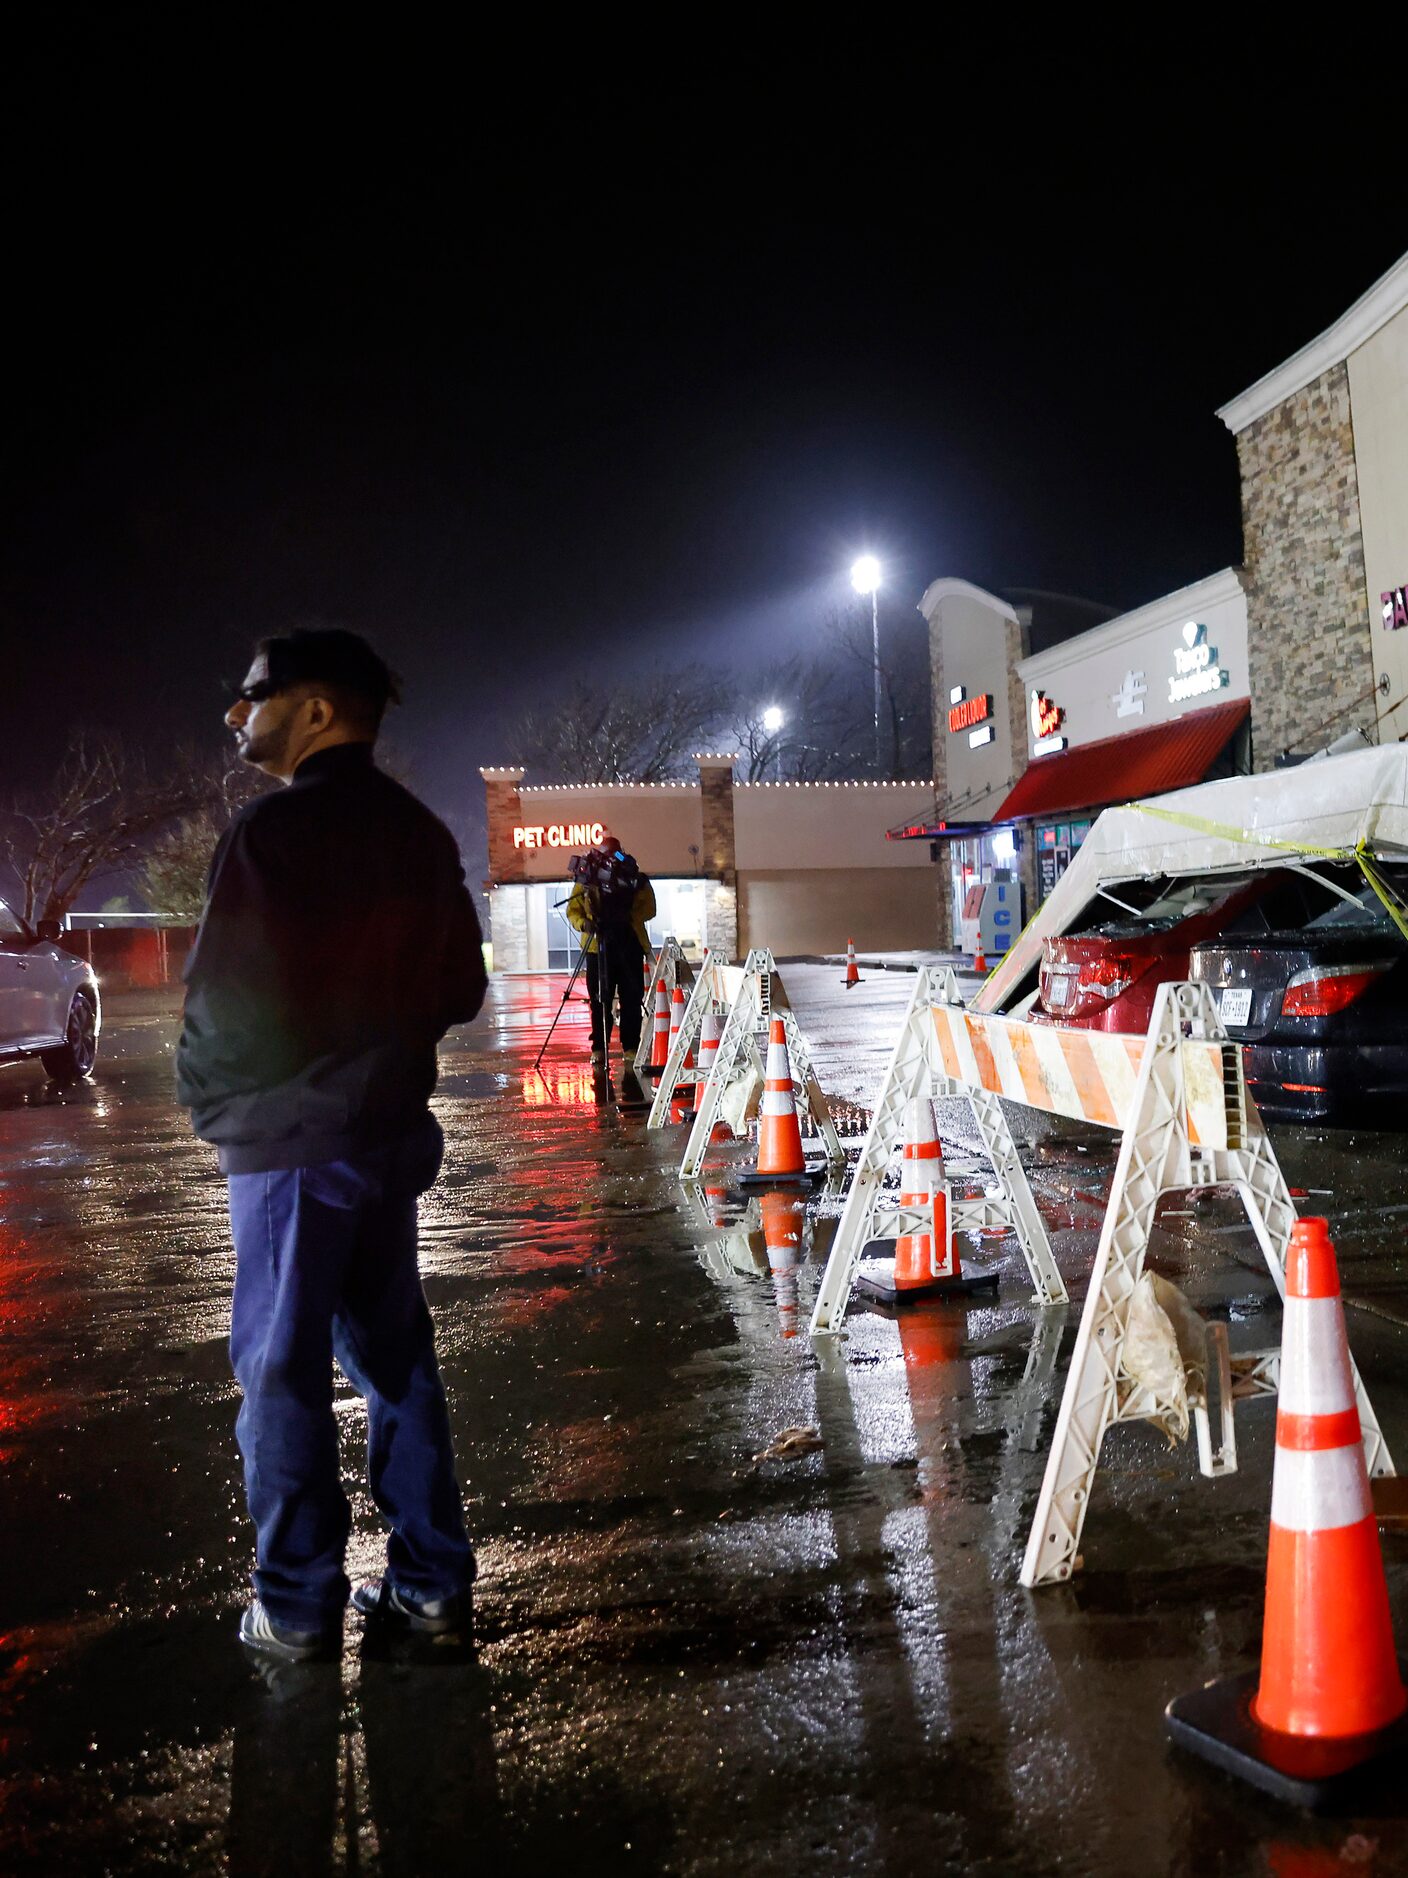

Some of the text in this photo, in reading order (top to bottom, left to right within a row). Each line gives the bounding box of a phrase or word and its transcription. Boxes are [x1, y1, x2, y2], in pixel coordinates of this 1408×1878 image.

[513, 823, 604, 848] PET CLINIC
[993, 885, 1012, 951] ICE
